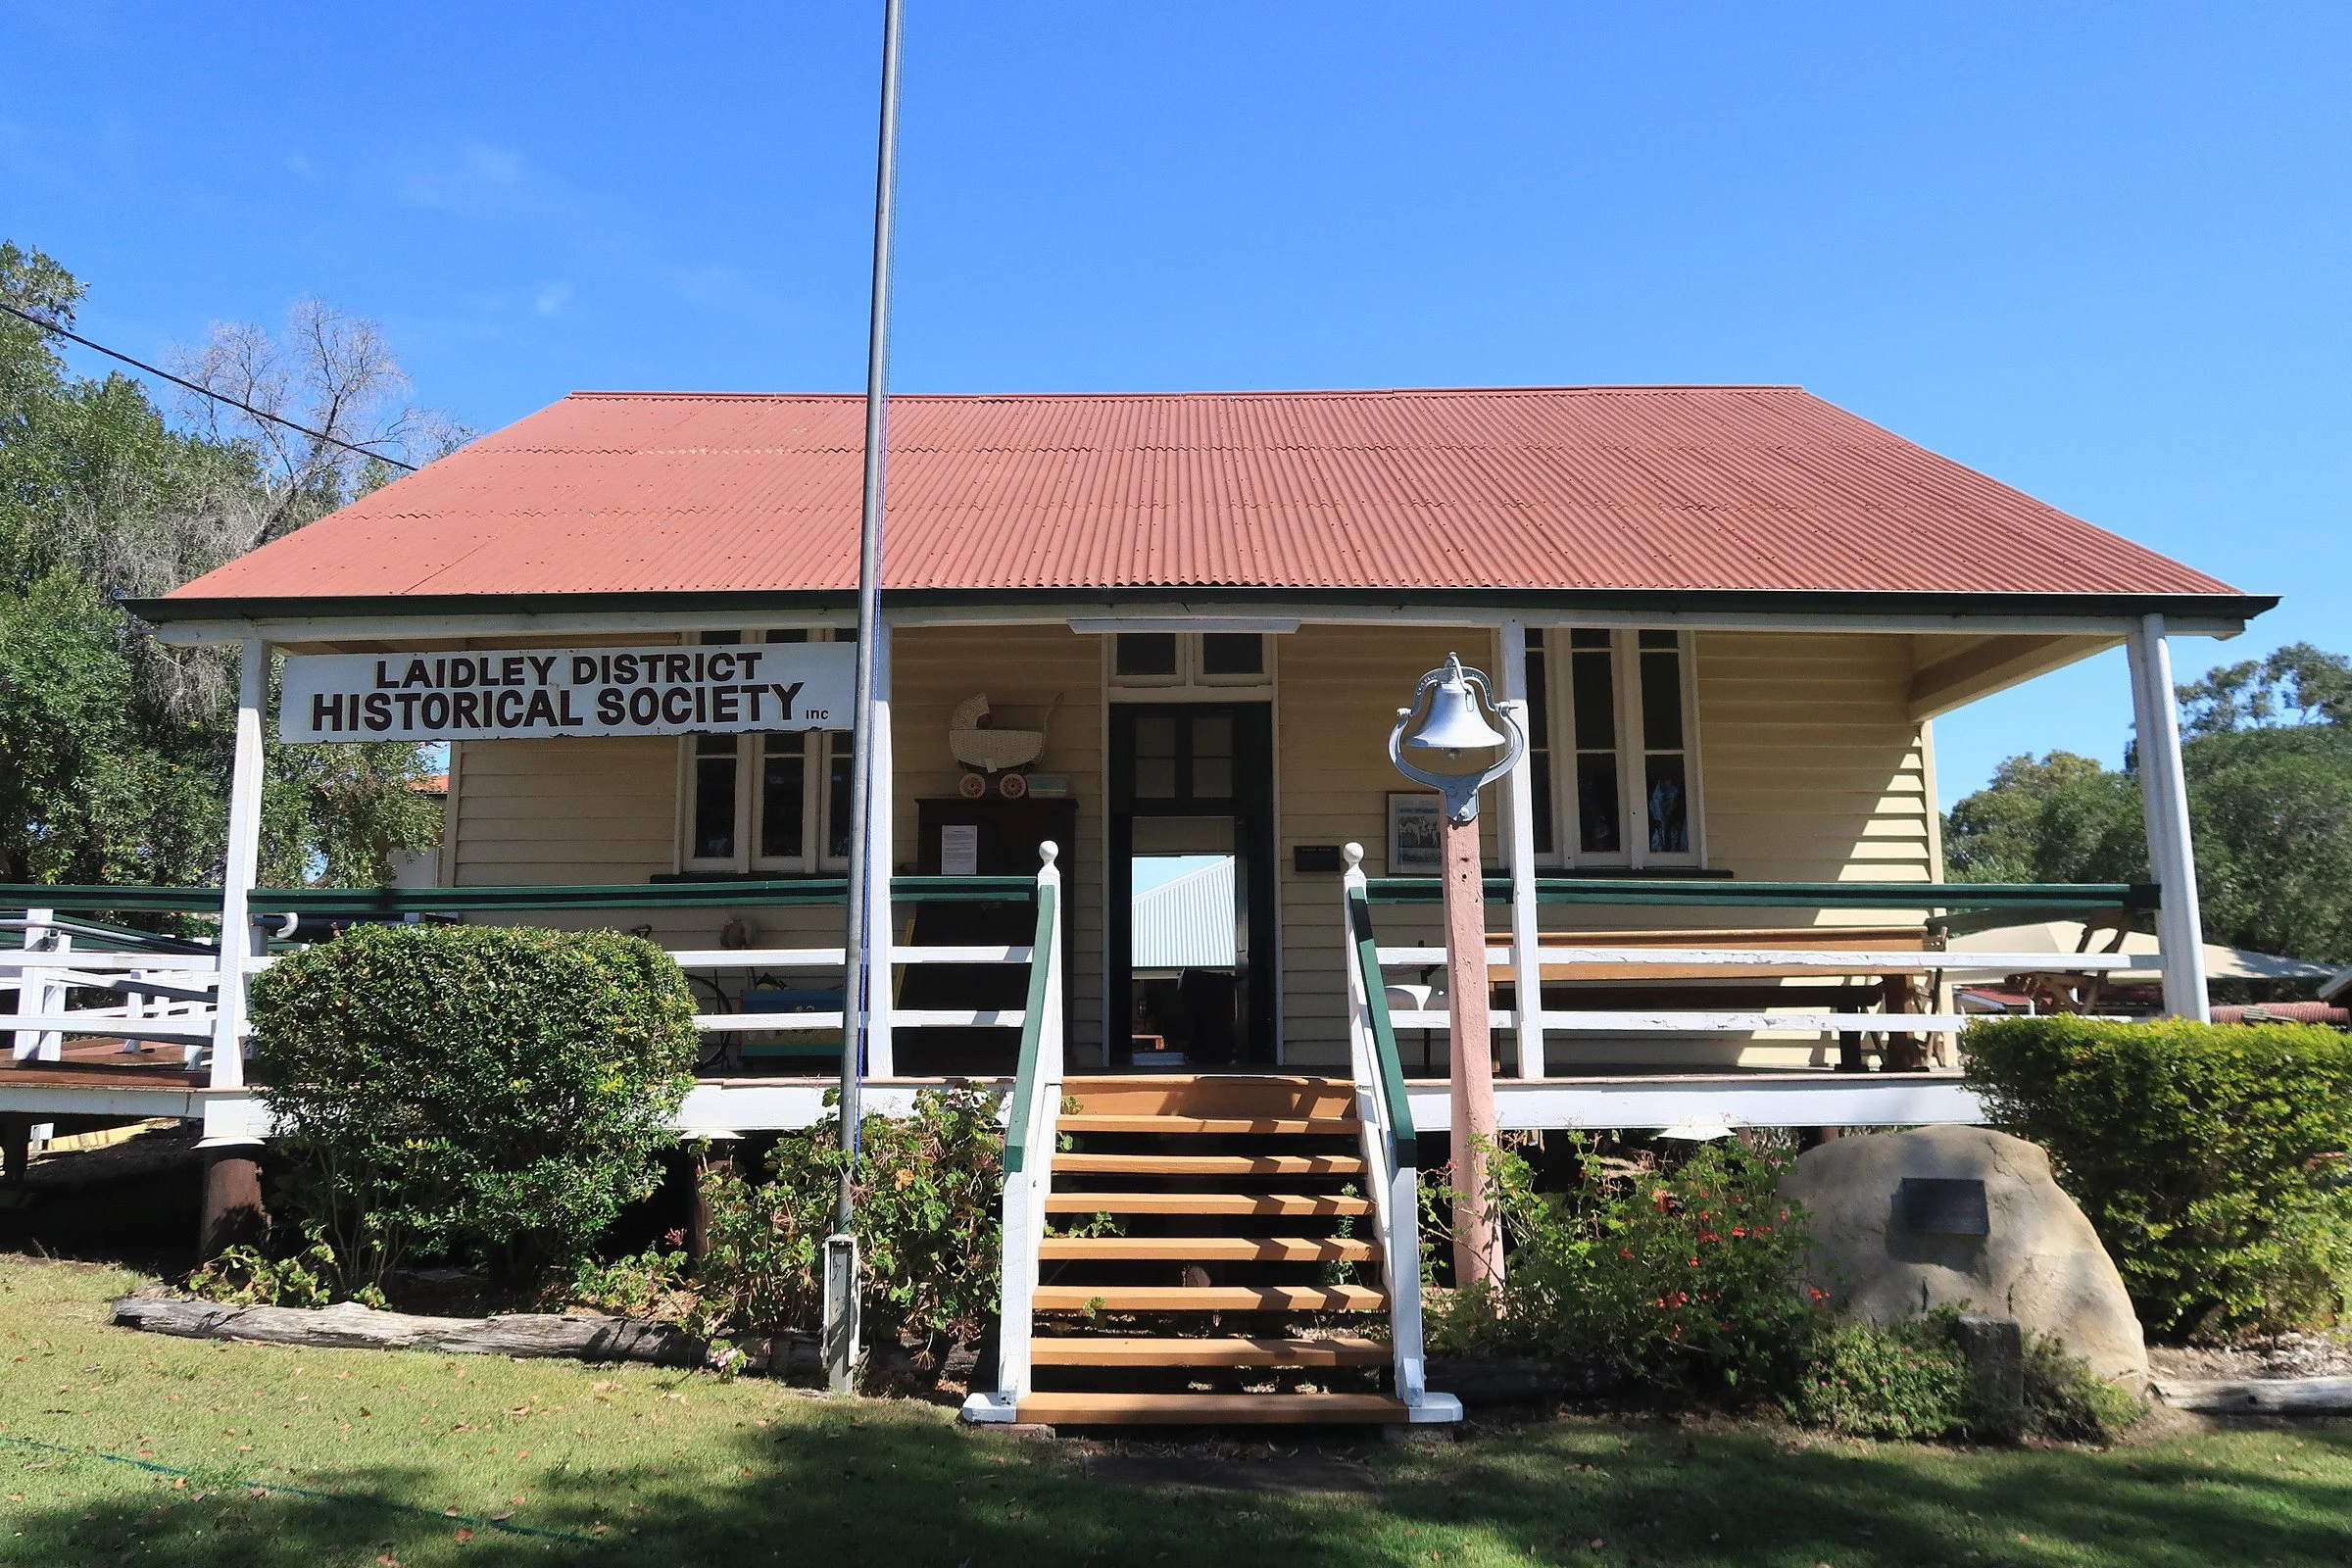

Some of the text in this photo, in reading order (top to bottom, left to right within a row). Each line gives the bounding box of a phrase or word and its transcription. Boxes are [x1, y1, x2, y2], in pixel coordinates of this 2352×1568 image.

[375, 651, 763, 689] LAIDLEY DISTRICT
[312, 688, 584, 732] HISTORICAL
[596, 681, 806, 728] SOCIETY
